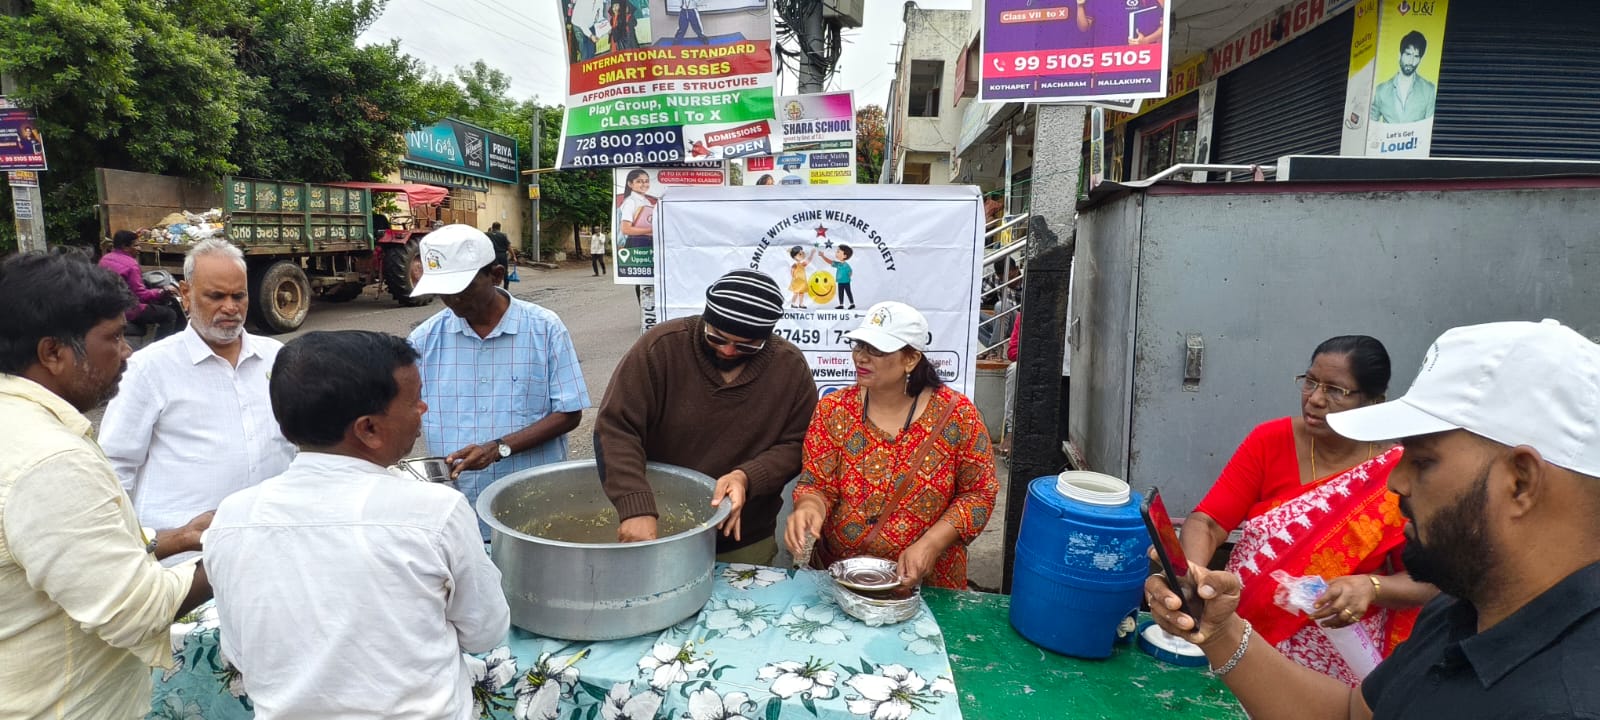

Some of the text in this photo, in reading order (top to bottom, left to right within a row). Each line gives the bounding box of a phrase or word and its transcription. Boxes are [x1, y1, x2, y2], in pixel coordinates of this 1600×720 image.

[582, 44, 755, 72] INTERNATIONAL STANDARD
[1014, 50, 1151, 71] 99 5105 5105
[1212, 37, 1246, 74] NAV
[598, 61, 731, 85] SMART CLASSES
[582, 76, 758, 102] AFFORDABLE FEE STRUCTURE
[990, 83, 1030, 91] KOTHAPET
[1098, 77, 1152, 86] NALLAKUNTA
[589, 93, 740, 116] Play Group, NURSERY
[601, 110, 721, 127] CLASSES I To X
[708, 125, 762, 143] ADMISSIONS
[783, 120, 851, 135] SHARA SCHOOL
[576, 131, 676, 151] 728 800 2000
[724, 140, 764, 156] OPEN
[1381, 137, 1417, 152] Loud!
[493, 143, 512, 158] PRIYA
[573, 154, 608, 166] 8019
[613, 151, 644, 164] 008
[647, 149, 679, 162] 009
[403, 167, 446, 184] RESTAURANT
[750, 210, 896, 272] SMILE WITH SHINE WELFARE SOCIETY
[782, 312, 815, 320] ONTACT
[817, 356, 849, 365] Twitter:
